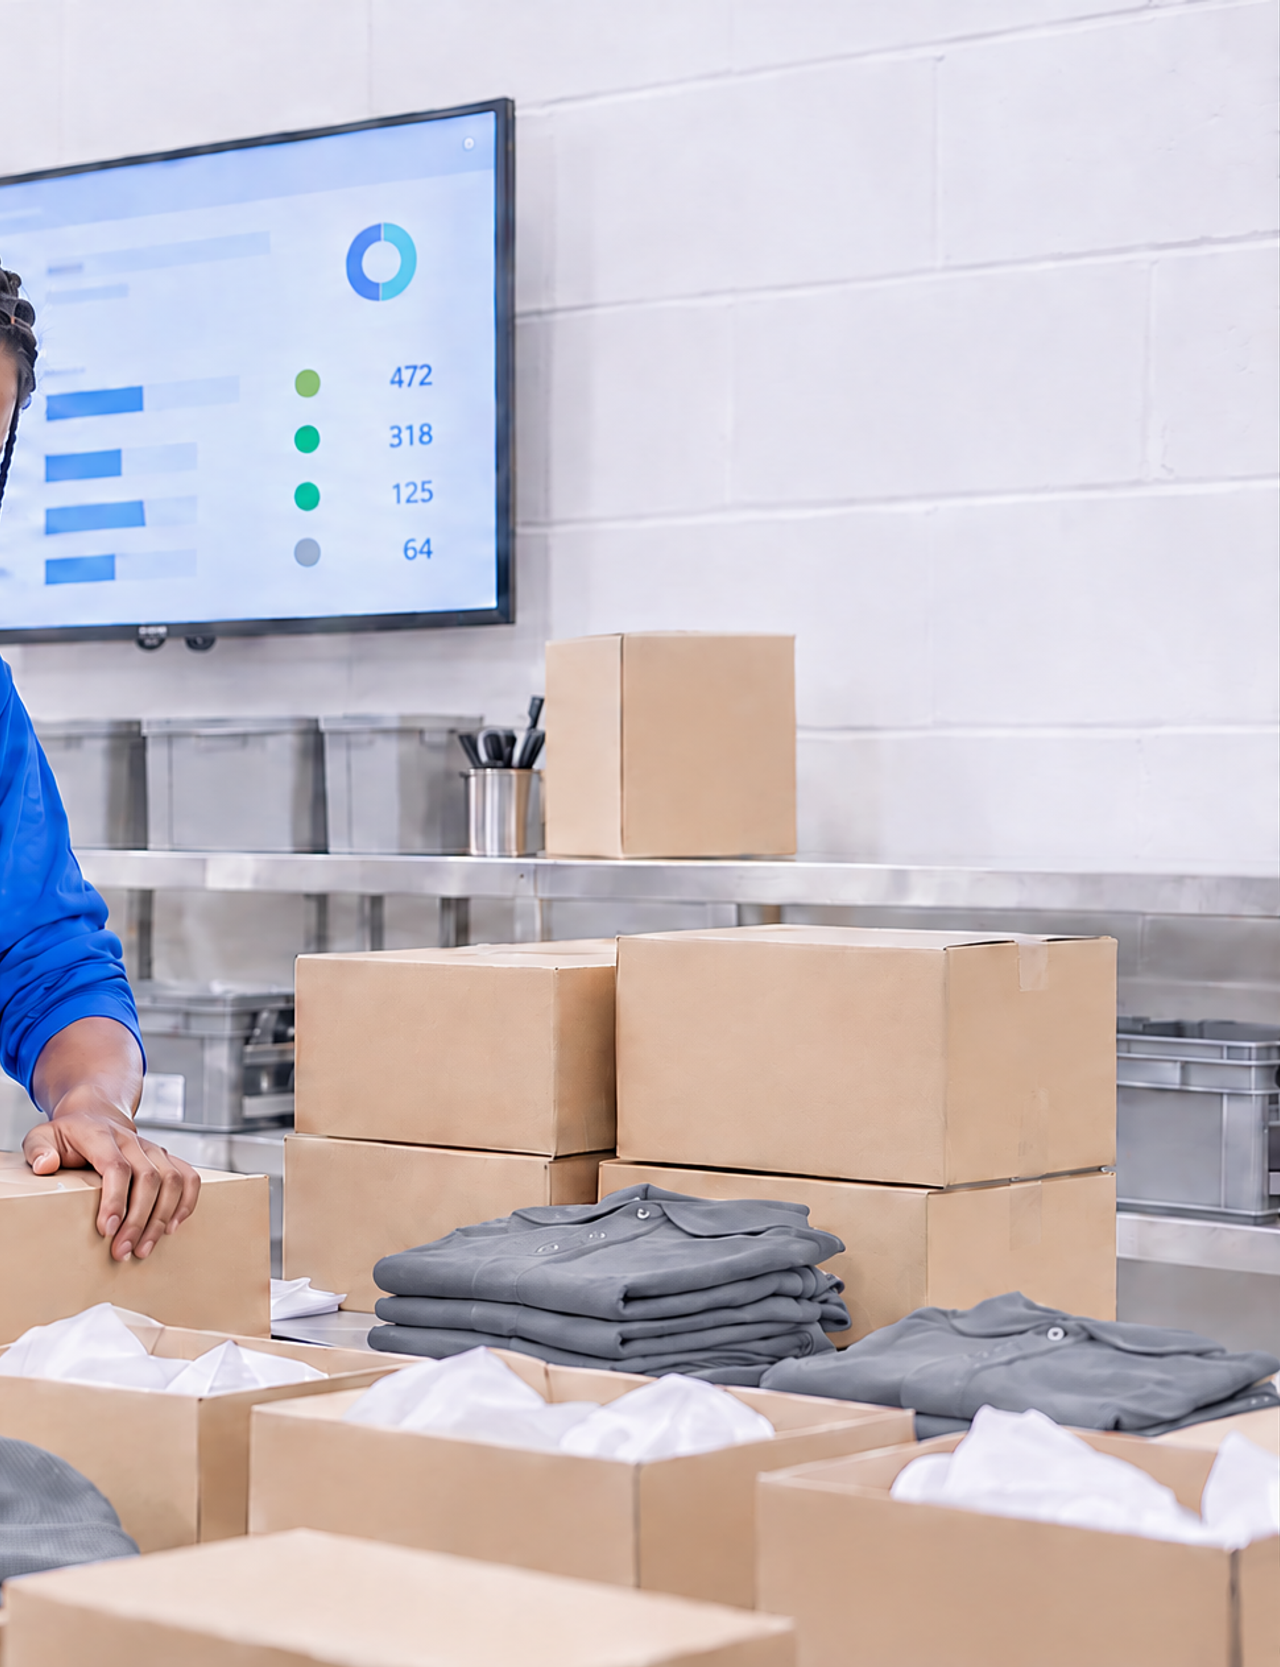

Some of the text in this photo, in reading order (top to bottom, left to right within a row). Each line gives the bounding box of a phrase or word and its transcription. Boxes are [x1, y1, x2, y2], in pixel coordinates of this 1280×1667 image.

[389, 363, 434, 389] 472
[389, 422, 434, 449] 318
[392, 479, 434, 505] 125
[402, 537, 434, 561] 64
